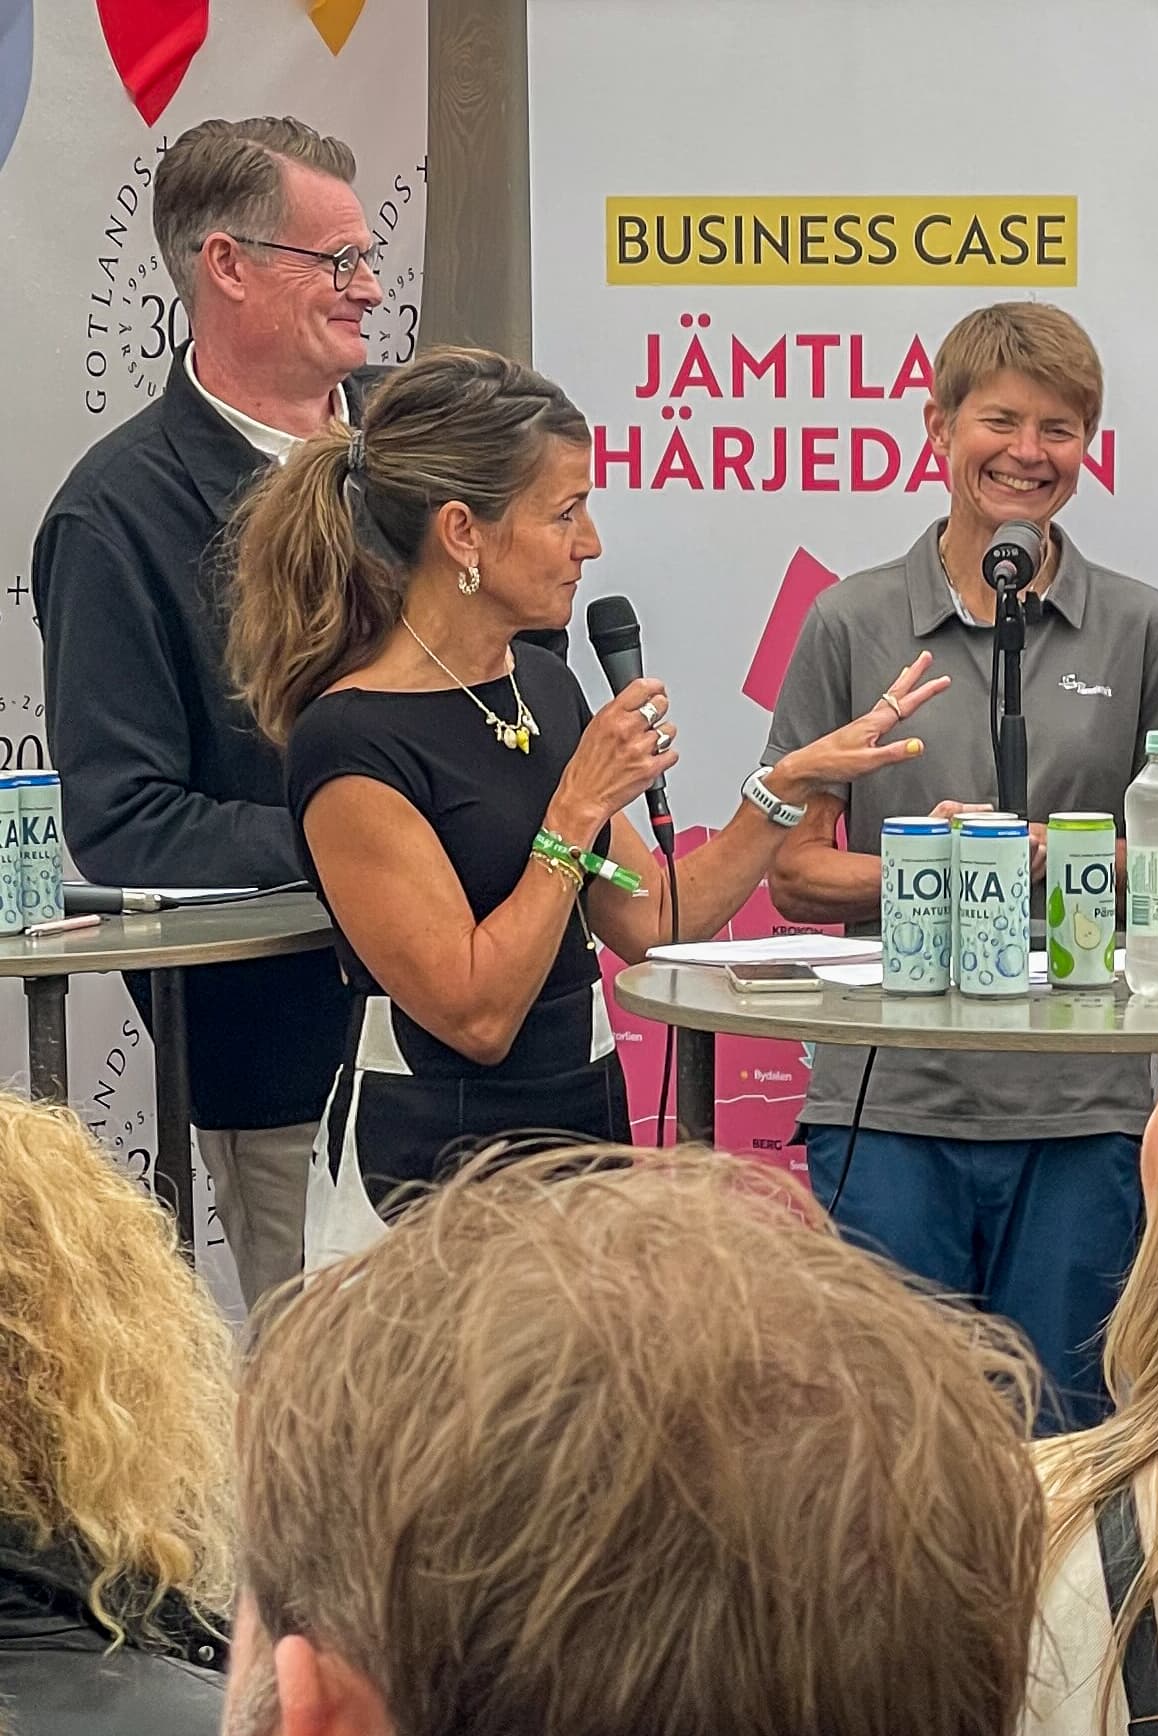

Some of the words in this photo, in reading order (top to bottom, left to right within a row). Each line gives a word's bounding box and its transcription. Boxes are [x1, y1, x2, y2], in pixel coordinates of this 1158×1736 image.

[617, 215, 898, 264] BUSINESS
[914, 214, 1067, 265] CASE
[85, 156, 152, 414] GOTLANDS
[396, 304, 418, 364] 3
[635, 313, 934, 399] JÄMTLA
[592, 406, 1116, 495] HÄRJEDAN
[21, 815, 58, 845] KA
[960, 870, 1005, 903] KA
[752, 1139, 783, 1151] BERG
